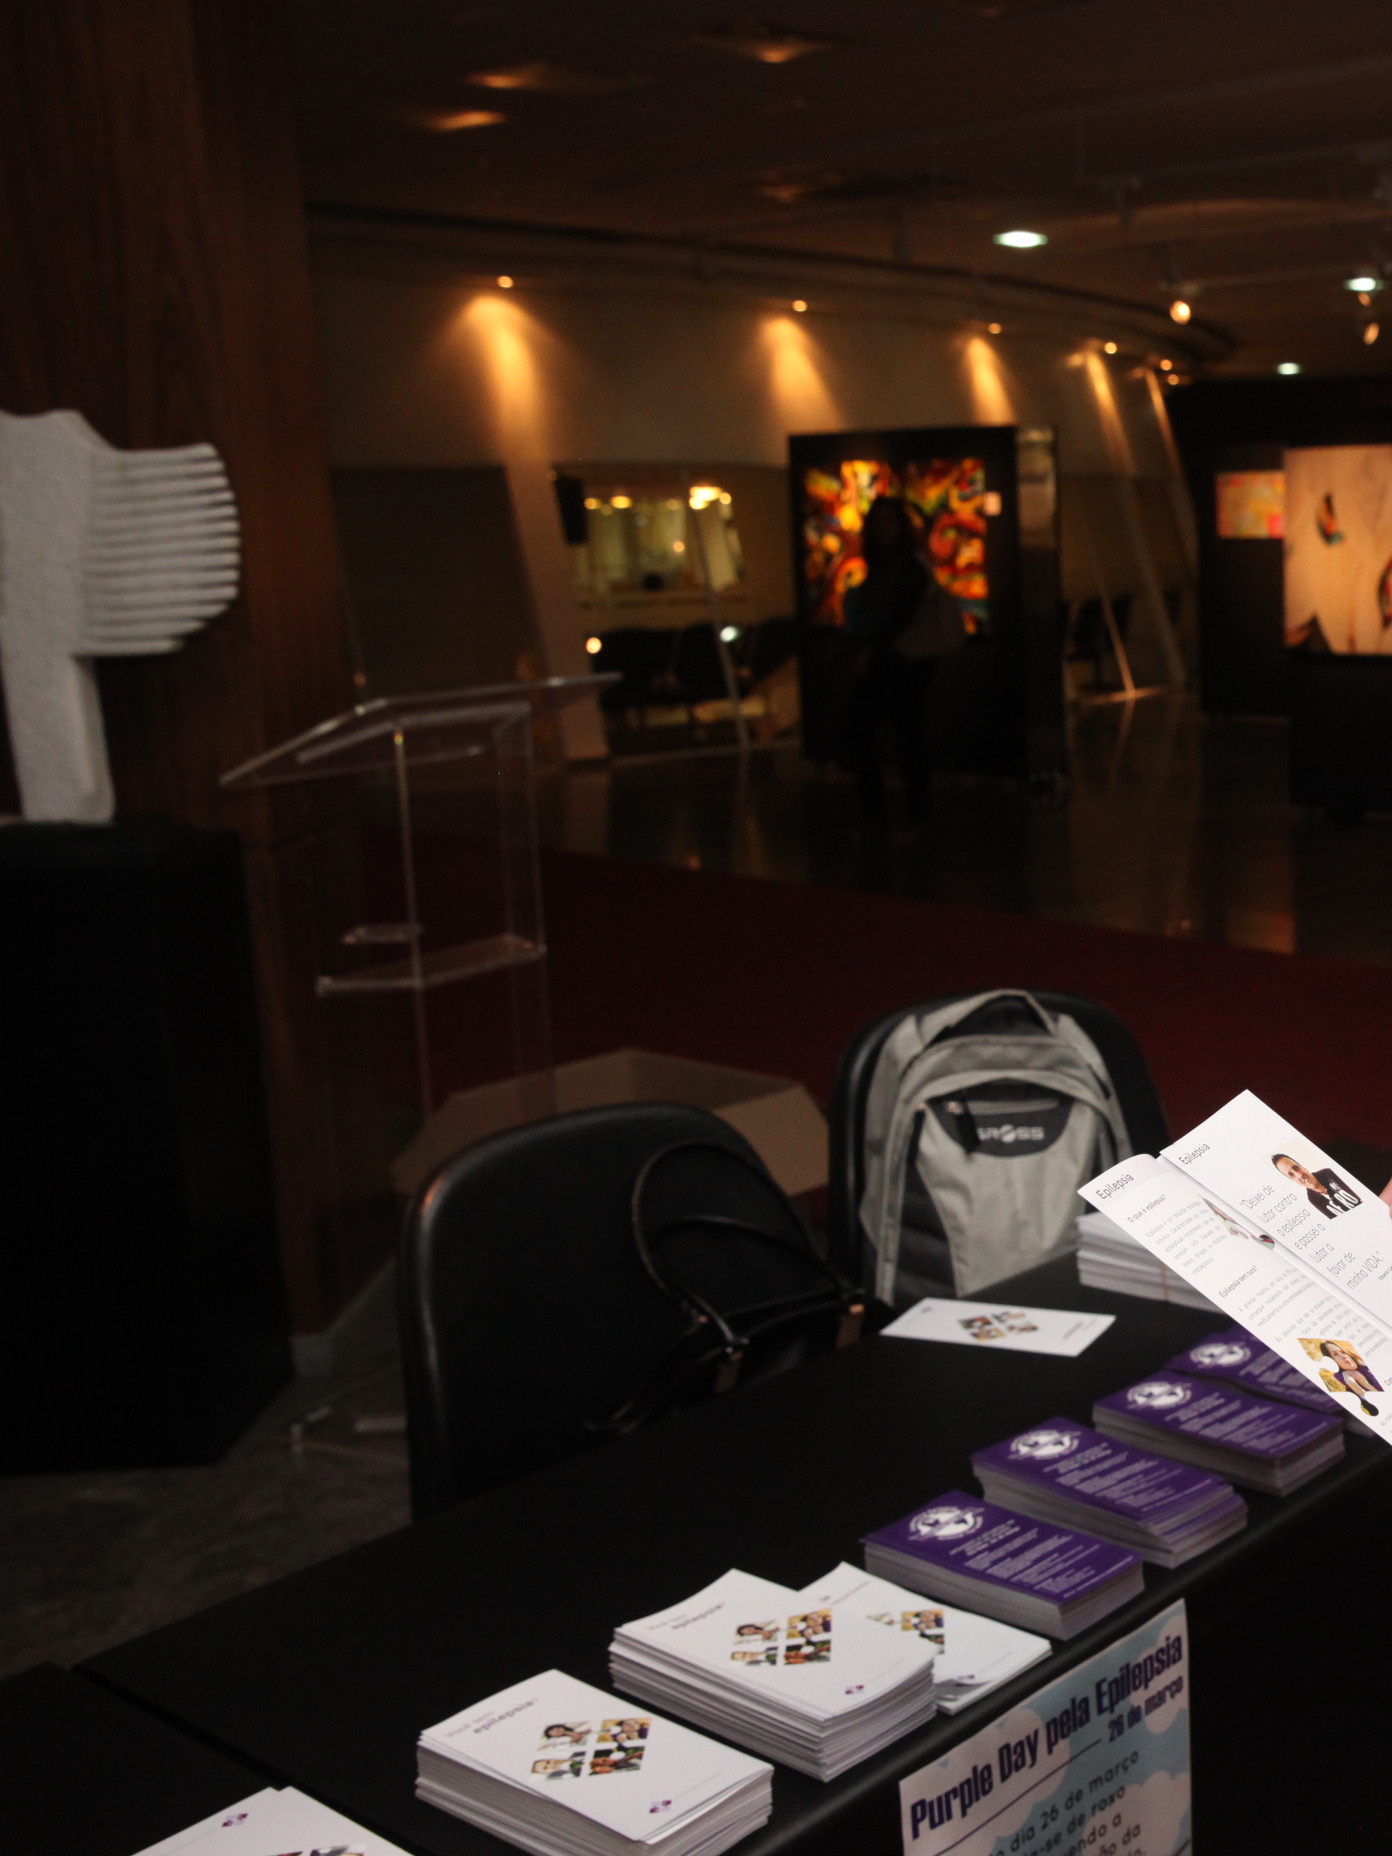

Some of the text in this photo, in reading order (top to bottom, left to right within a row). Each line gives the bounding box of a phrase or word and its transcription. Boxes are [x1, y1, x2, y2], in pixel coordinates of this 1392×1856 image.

[1178, 1143, 1211, 1165] Epilepsia
[1095, 1174, 1134, 1200] Epilepsia
[1262, 1185, 1275, 1196] de
[1257, 1193, 1298, 1224] lutar contra
[1277, 1209, 1311, 1237] a epilepsia
[1294, 1223, 1326, 1250] e passei a
[1309, 1243, 1334, 1263] lutar a
[1327, 1252, 1356, 1278] favor de
[1218, 1265, 1257, 1298] Epilepsia tem cura?
[1346, 1269, 1368, 1290] minha
[1107, 1676, 1184, 1742] 26 de março
[911, 1635, 1184, 1841] Purple Day pela Epilepsia
[1011, 1829, 1036, 1853] dia
[1041, 1807, 1059, 1830] 26
[1065, 1788, 1083, 1811] de
[1089, 1749, 1139, 1793] março
[1067, 1813, 1086, 1834] de
[1090, 1785, 1126, 1818] roxo
[1112, 1813, 1123, 1829] a
[1122, 1824, 1142, 1845] da
